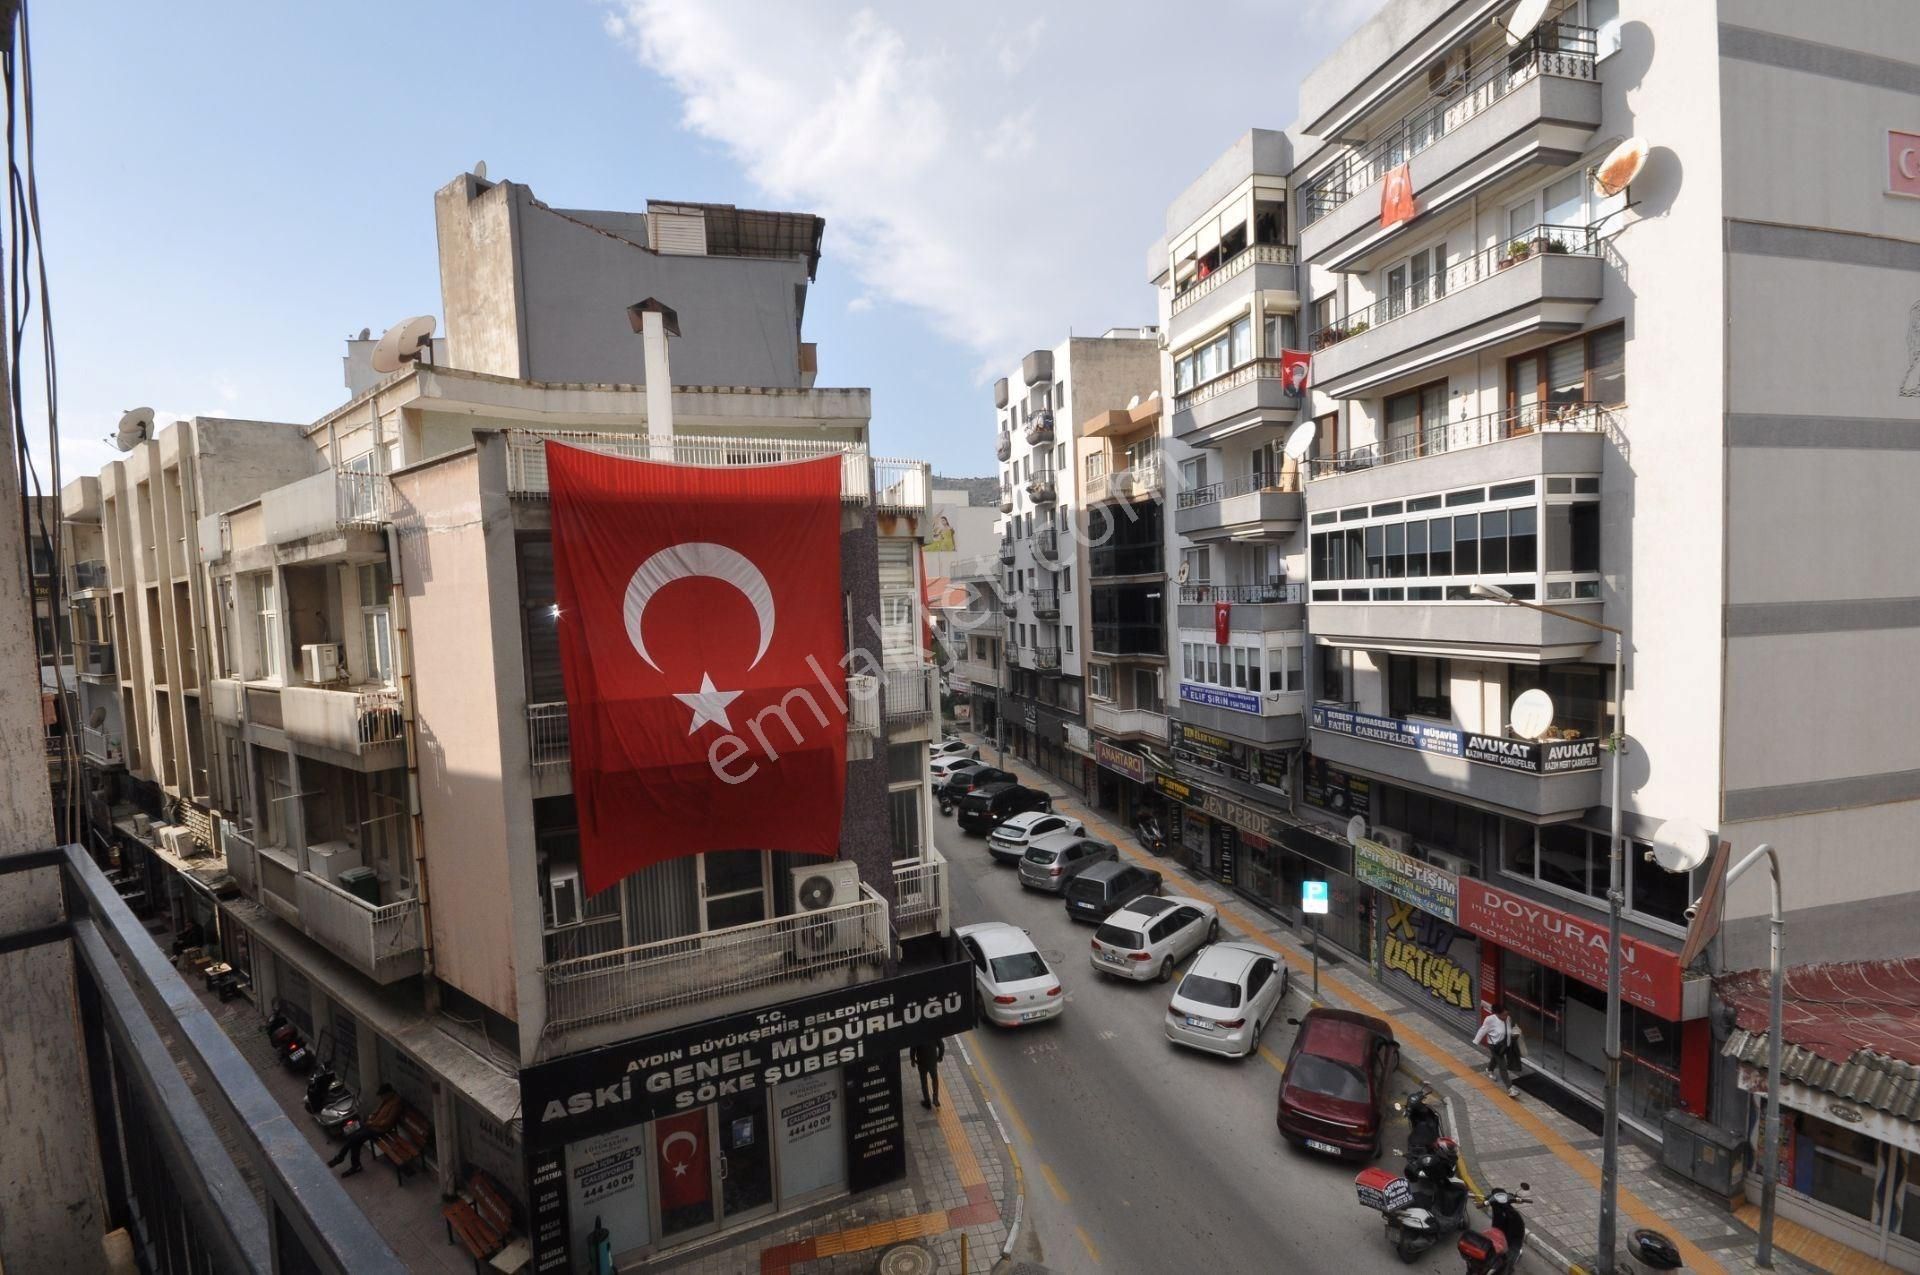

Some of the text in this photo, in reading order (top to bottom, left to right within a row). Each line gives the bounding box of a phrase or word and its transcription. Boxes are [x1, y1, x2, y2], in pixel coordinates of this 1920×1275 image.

[1328, 711, 1458, 741] SERBEST MUHASEBECİ MALİ MÜŞAVİR
[1328, 720, 1415, 745] FATİH ÇARKIFELEK
[1101, 746, 1141, 773] ANAHTARCI
[1469, 737, 1529, 758] AVUKAT
[1548, 743, 1595, 760] AVUKAT
[1465, 749, 1536, 771] KAZIM MERT ÇARKIFELEK
[1544, 757, 1598, 771] KAZIM MERT ÇARKIFELEK
[1202, 794, 1270, 835] ZEN PERDE
[1392, 859, 1456, 895] İLETİŞİM
[1484, 892, 1635, 963] DOYURAN
[756, 1011, 786, 1025] T.C.
[626, 993, 895, 1073] AYDIN BÜYÜKŞEHİR BELEDİYESİ
[541, 1075, 632, 1122] ASKİ
[646, 1049, 761, 1093] GENEL
[771, 991, 962, 1060] MÜDÜRLÜĞÜ
[675, 1072, 756, 1109] SÖKE
[764, 1040, 864, 1088] ŞUBESİ
[789, 1115, 830, 1137] 444 40 09
[534, 1170, 562, 1185] KAPATMA
[537, 1161, 558, 1174] ABONE
[584, 1174, 634, 1198] 444 40 09
[1384, 1180, 1409, 1196] DOYURAN
